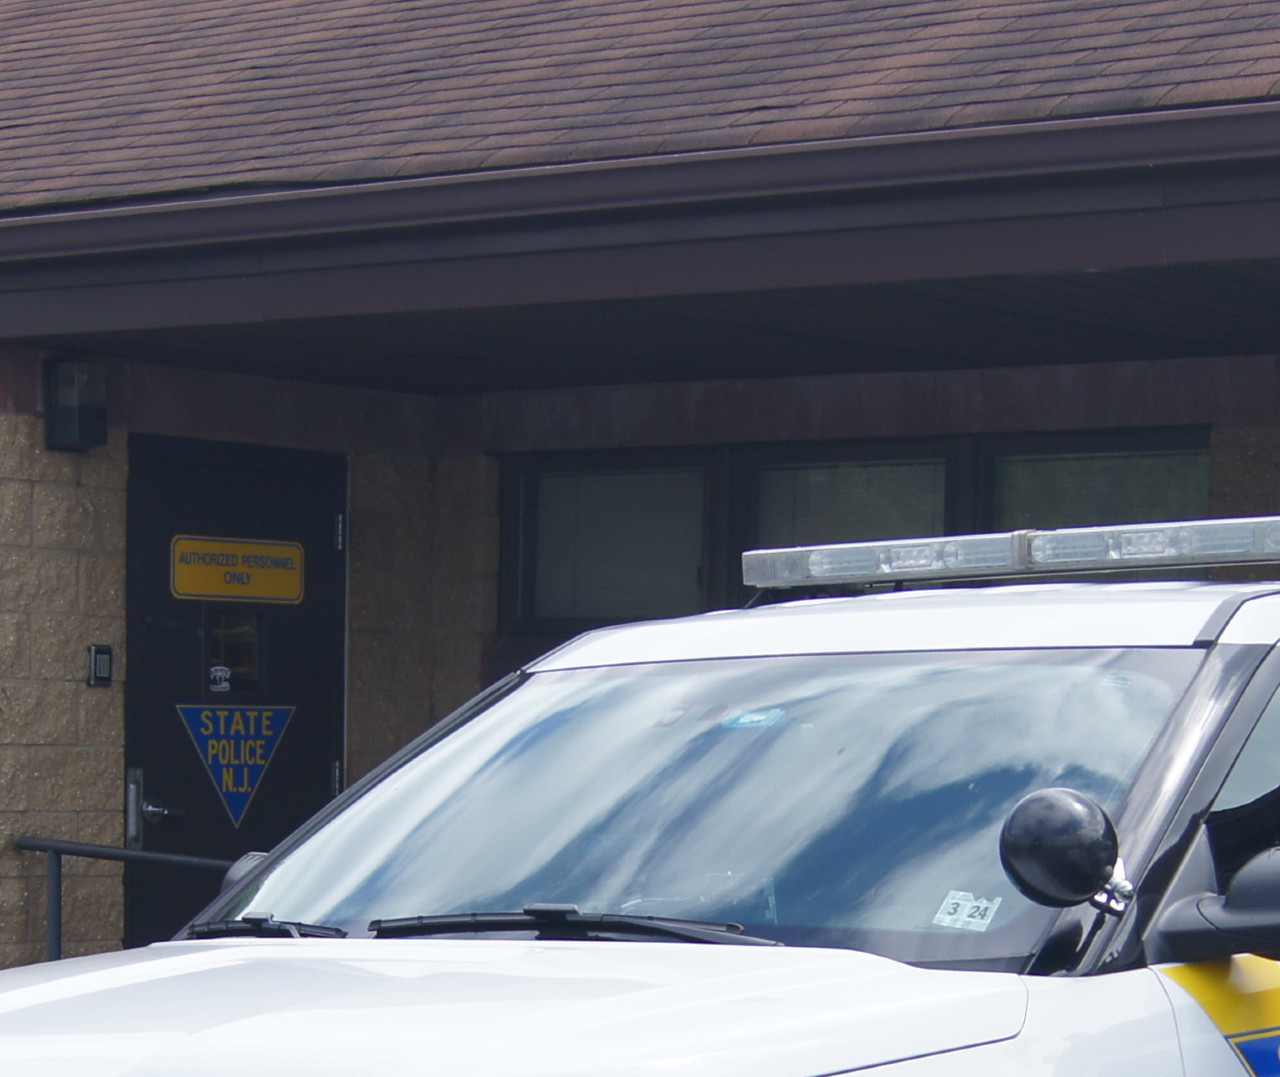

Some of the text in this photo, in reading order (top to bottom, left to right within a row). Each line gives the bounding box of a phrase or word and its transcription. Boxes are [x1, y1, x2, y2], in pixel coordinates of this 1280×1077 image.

[180, 552, 296, 570] AUTHORIZED PERSONNEL
[223, 571, 253, 585] ONLY
[200, 710, 273, 735] STATE
[208, 739, 265, 765] POLICE
[222, 767, 251, 793] N.J.
[947, 902, 989, 919] 3 24
